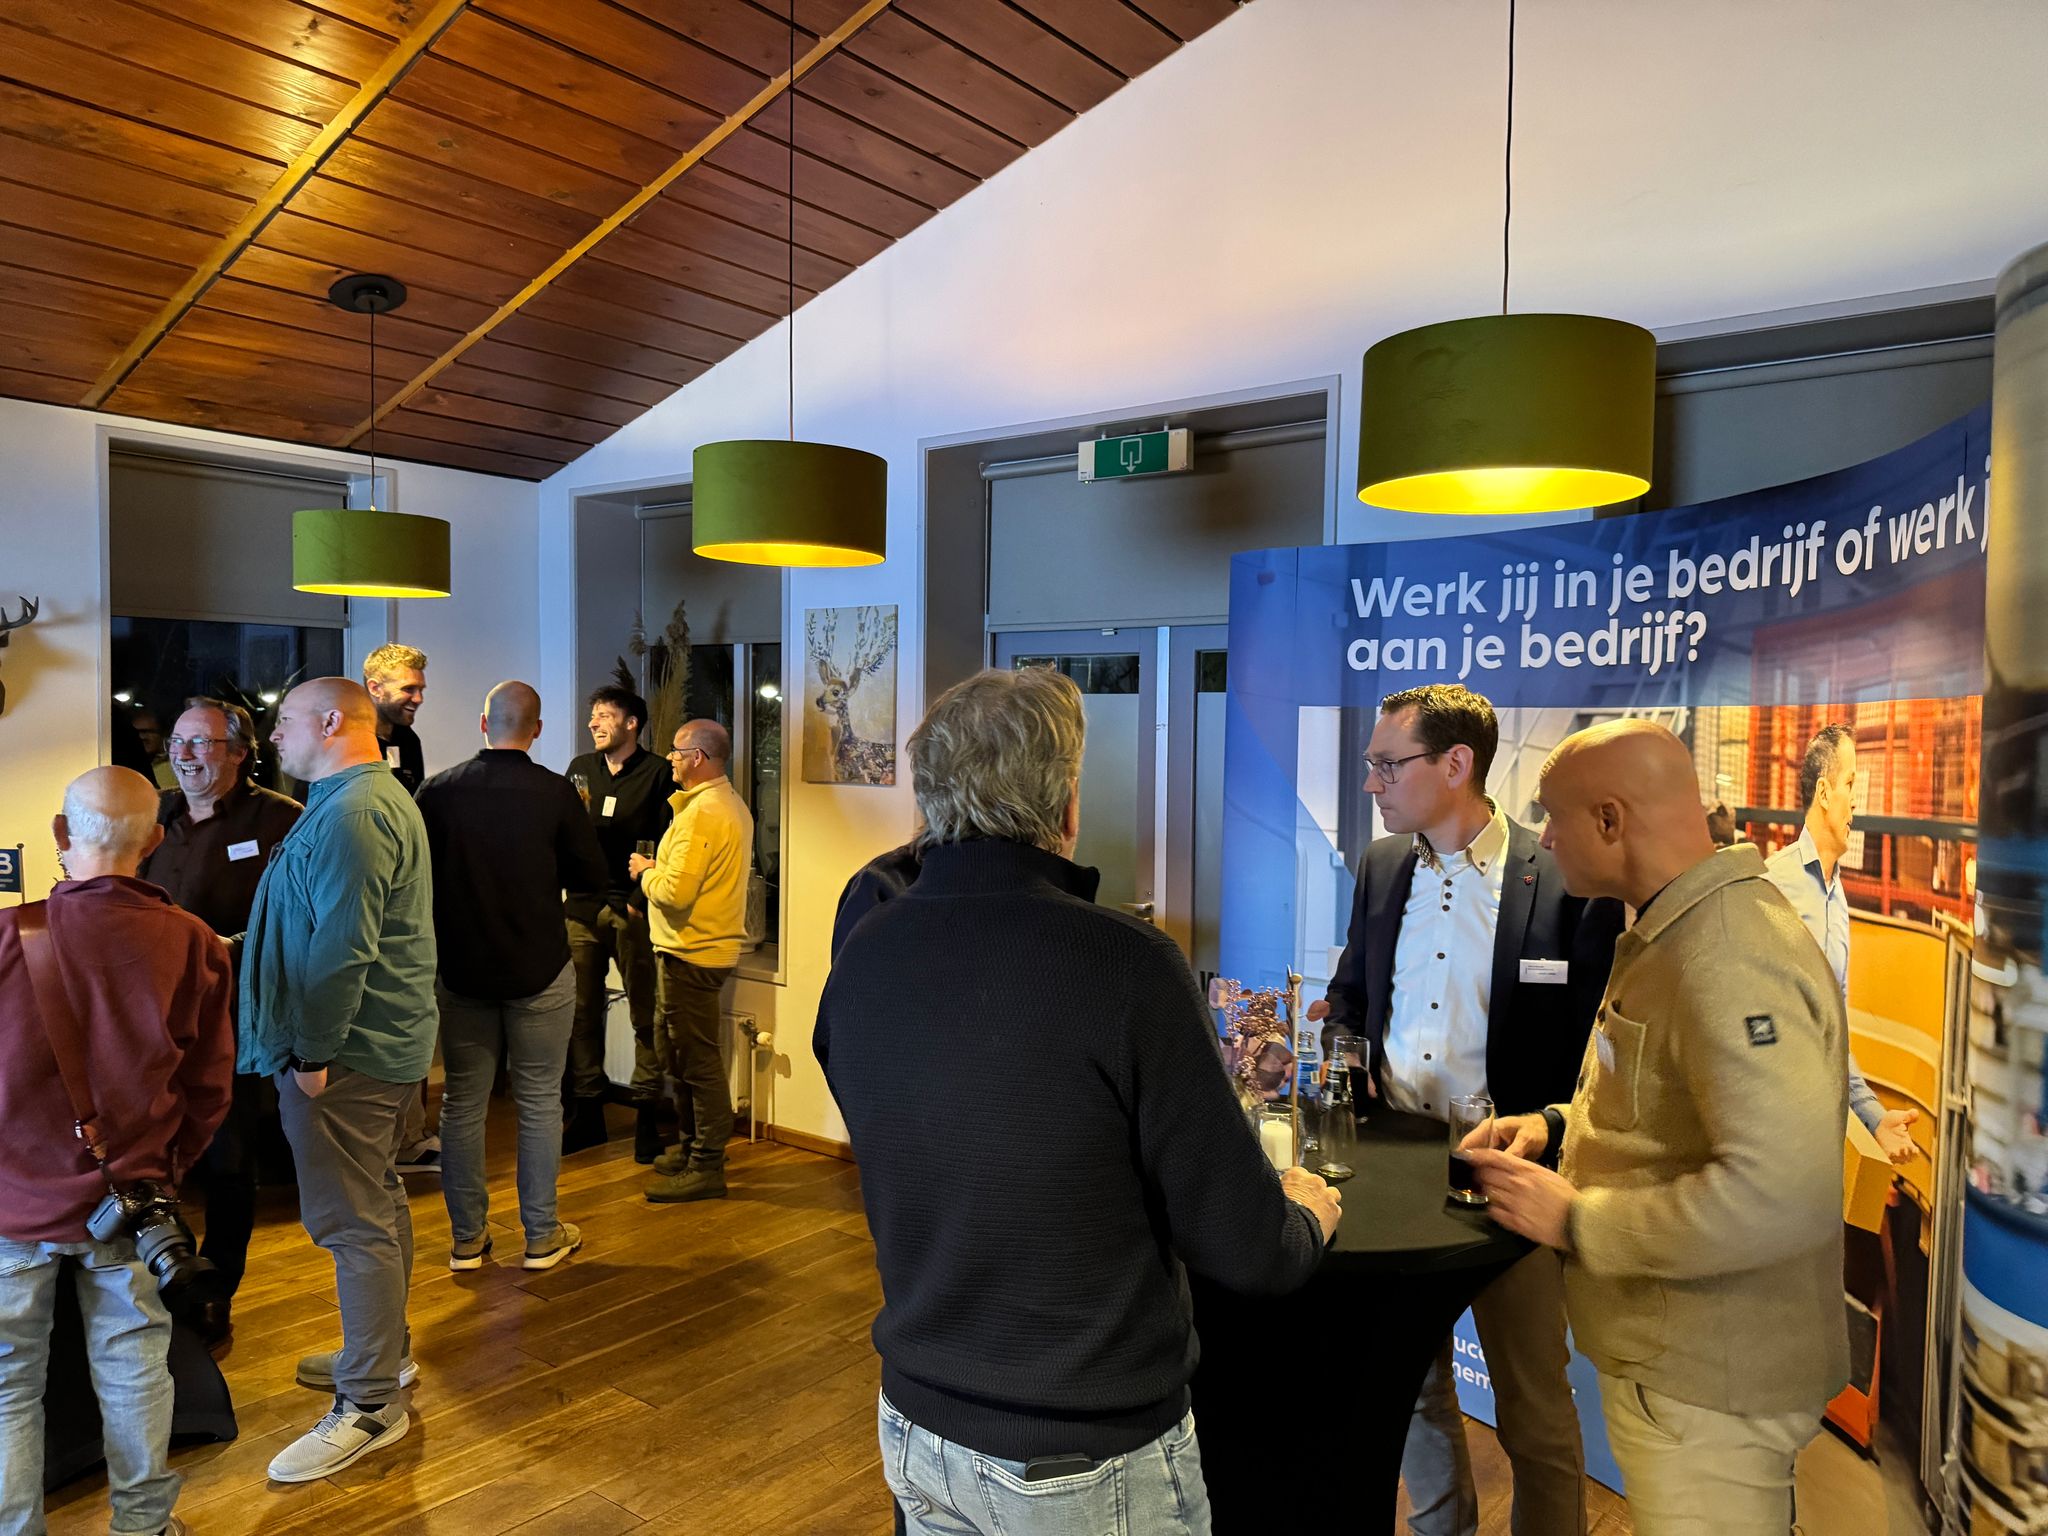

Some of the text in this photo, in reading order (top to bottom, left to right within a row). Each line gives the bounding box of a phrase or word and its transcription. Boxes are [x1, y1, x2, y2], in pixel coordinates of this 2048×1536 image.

[1351, 572, 1487, 618] Werk
[1497, 561, 1539, 623] jij
[1554, 559, 1597, 608] in
[1607, 553, 1654, 616] je
[1667, 520, 1826, 599] bedrijf
[1835, 505, 1882, 575] of
[1888, 474, 1976, 564] werk
[1347, 610, 1707, 680] aan je bedrijf?
